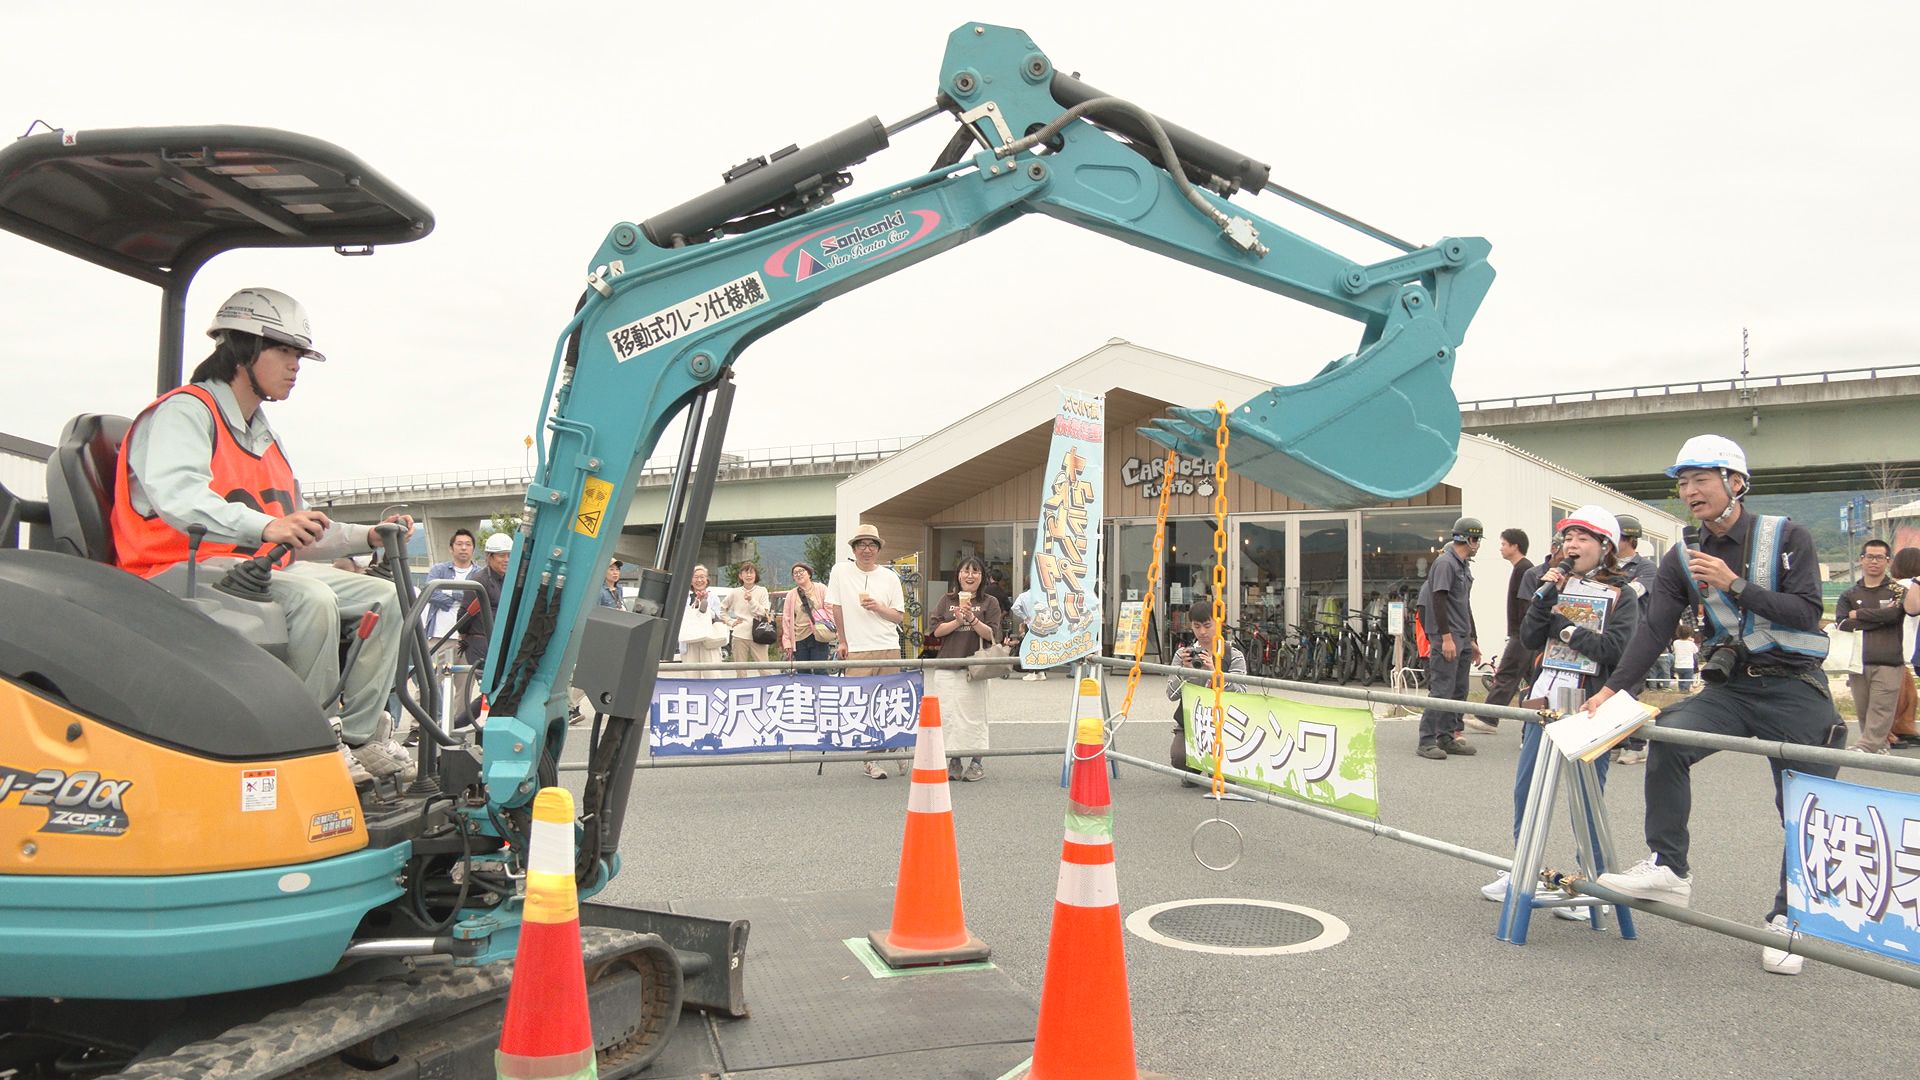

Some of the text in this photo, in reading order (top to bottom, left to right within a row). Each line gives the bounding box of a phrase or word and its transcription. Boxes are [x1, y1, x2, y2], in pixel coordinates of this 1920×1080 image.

[612, 277, 764, 358] 移動式クレーン仕様機
[659, 680, 917, 738] 中沢建設(株)
